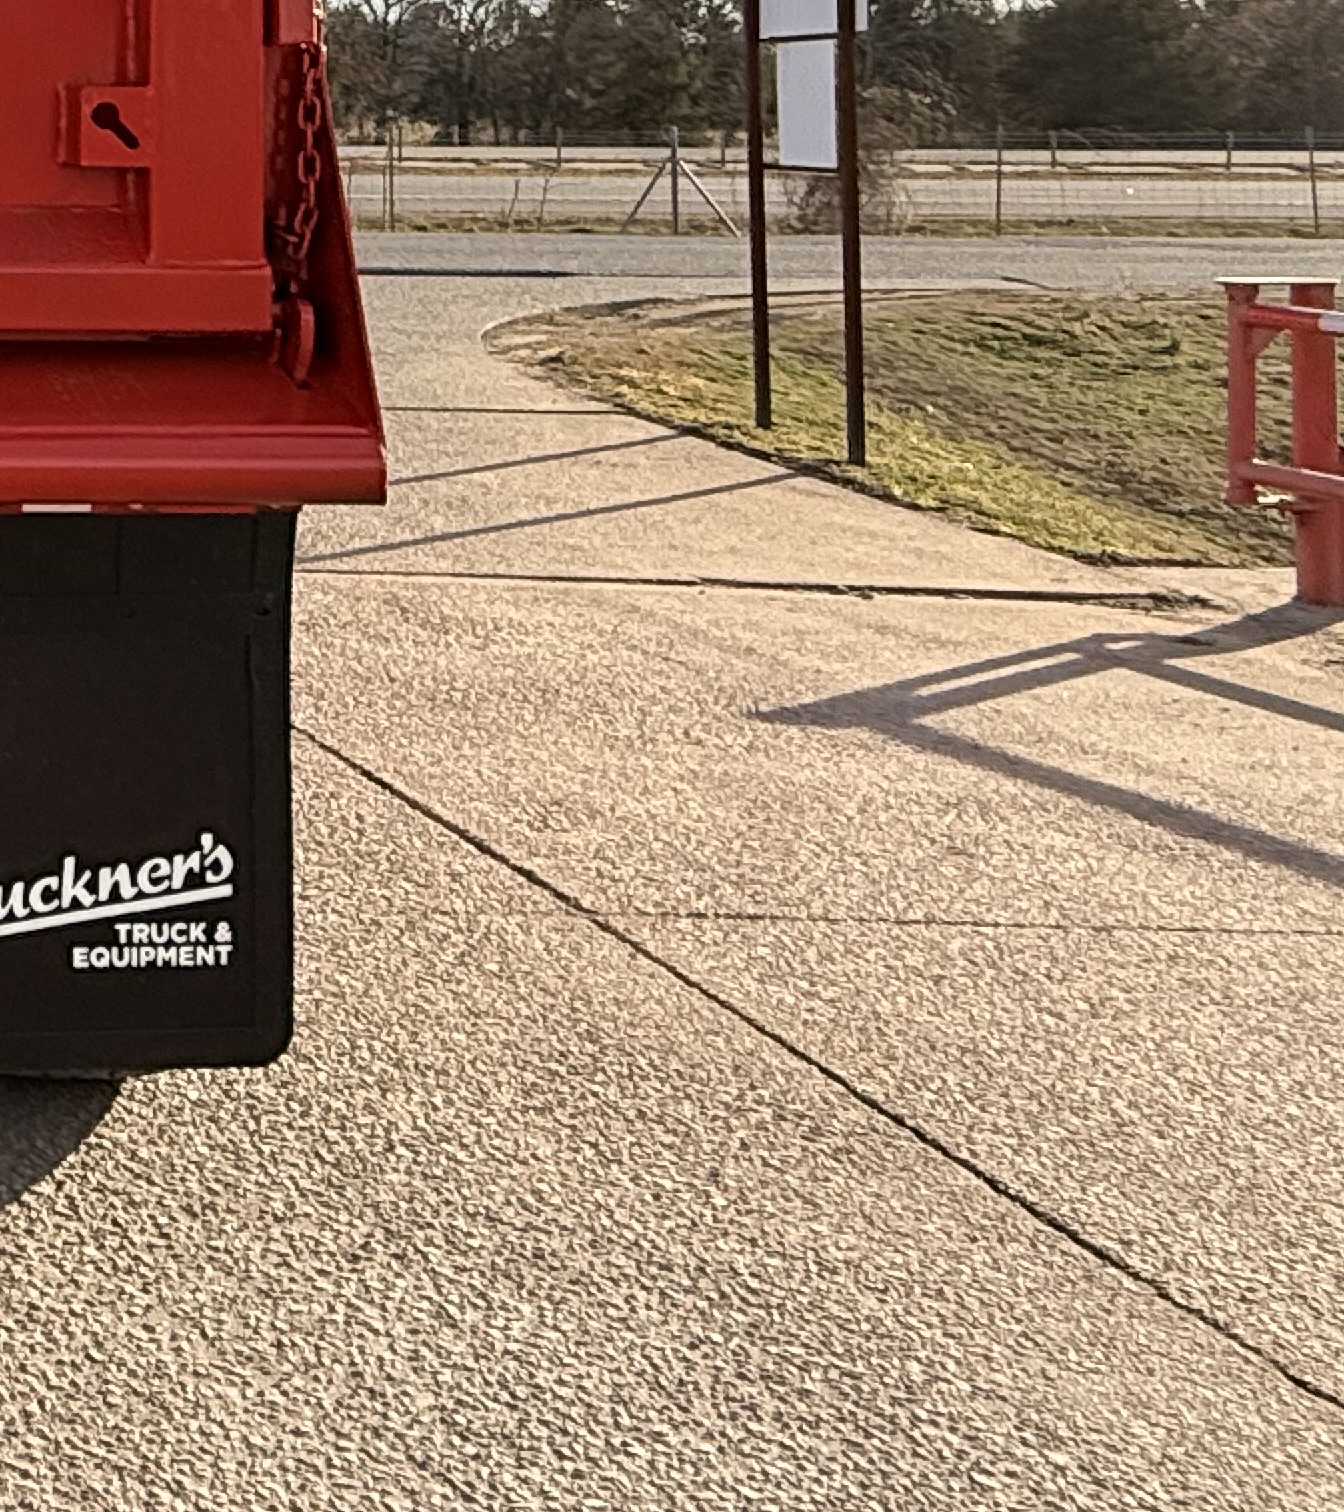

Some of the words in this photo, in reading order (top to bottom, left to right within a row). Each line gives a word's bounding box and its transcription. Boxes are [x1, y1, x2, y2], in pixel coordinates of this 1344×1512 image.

[114, 922, 207, 944] TRUCK
[214, 921, 233, 943] &
[72, 945, 233, 969] EQUIPMENT
